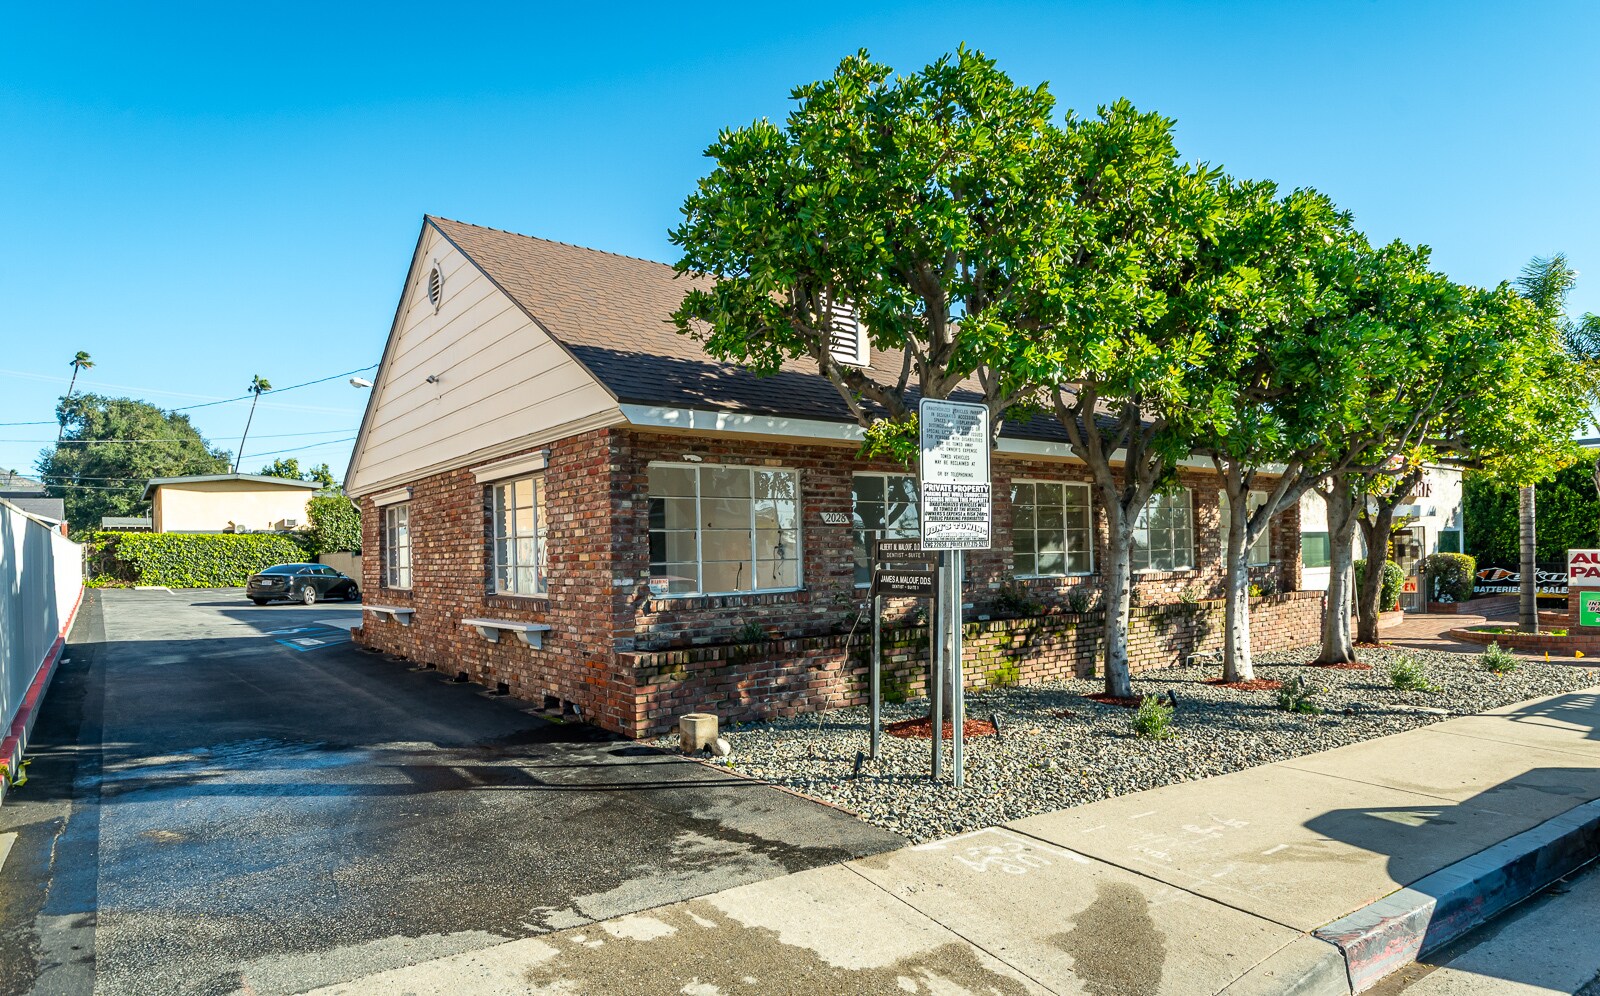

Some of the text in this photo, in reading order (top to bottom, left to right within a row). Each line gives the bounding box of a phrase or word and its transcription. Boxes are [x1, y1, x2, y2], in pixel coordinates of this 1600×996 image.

[953, 484, 988, 492] PROPERTY
[825, 512, 846, 522] 2028
[926, 524, 952, 536] JON'S
[954, 522, 988, 536] TOWING
[1570, 553, 1600, 564] AU
[1570, 566, 1600, 578] PA
[880, 575, 894, 584] JAMES
[1403, 583, 1416, 592] EN
